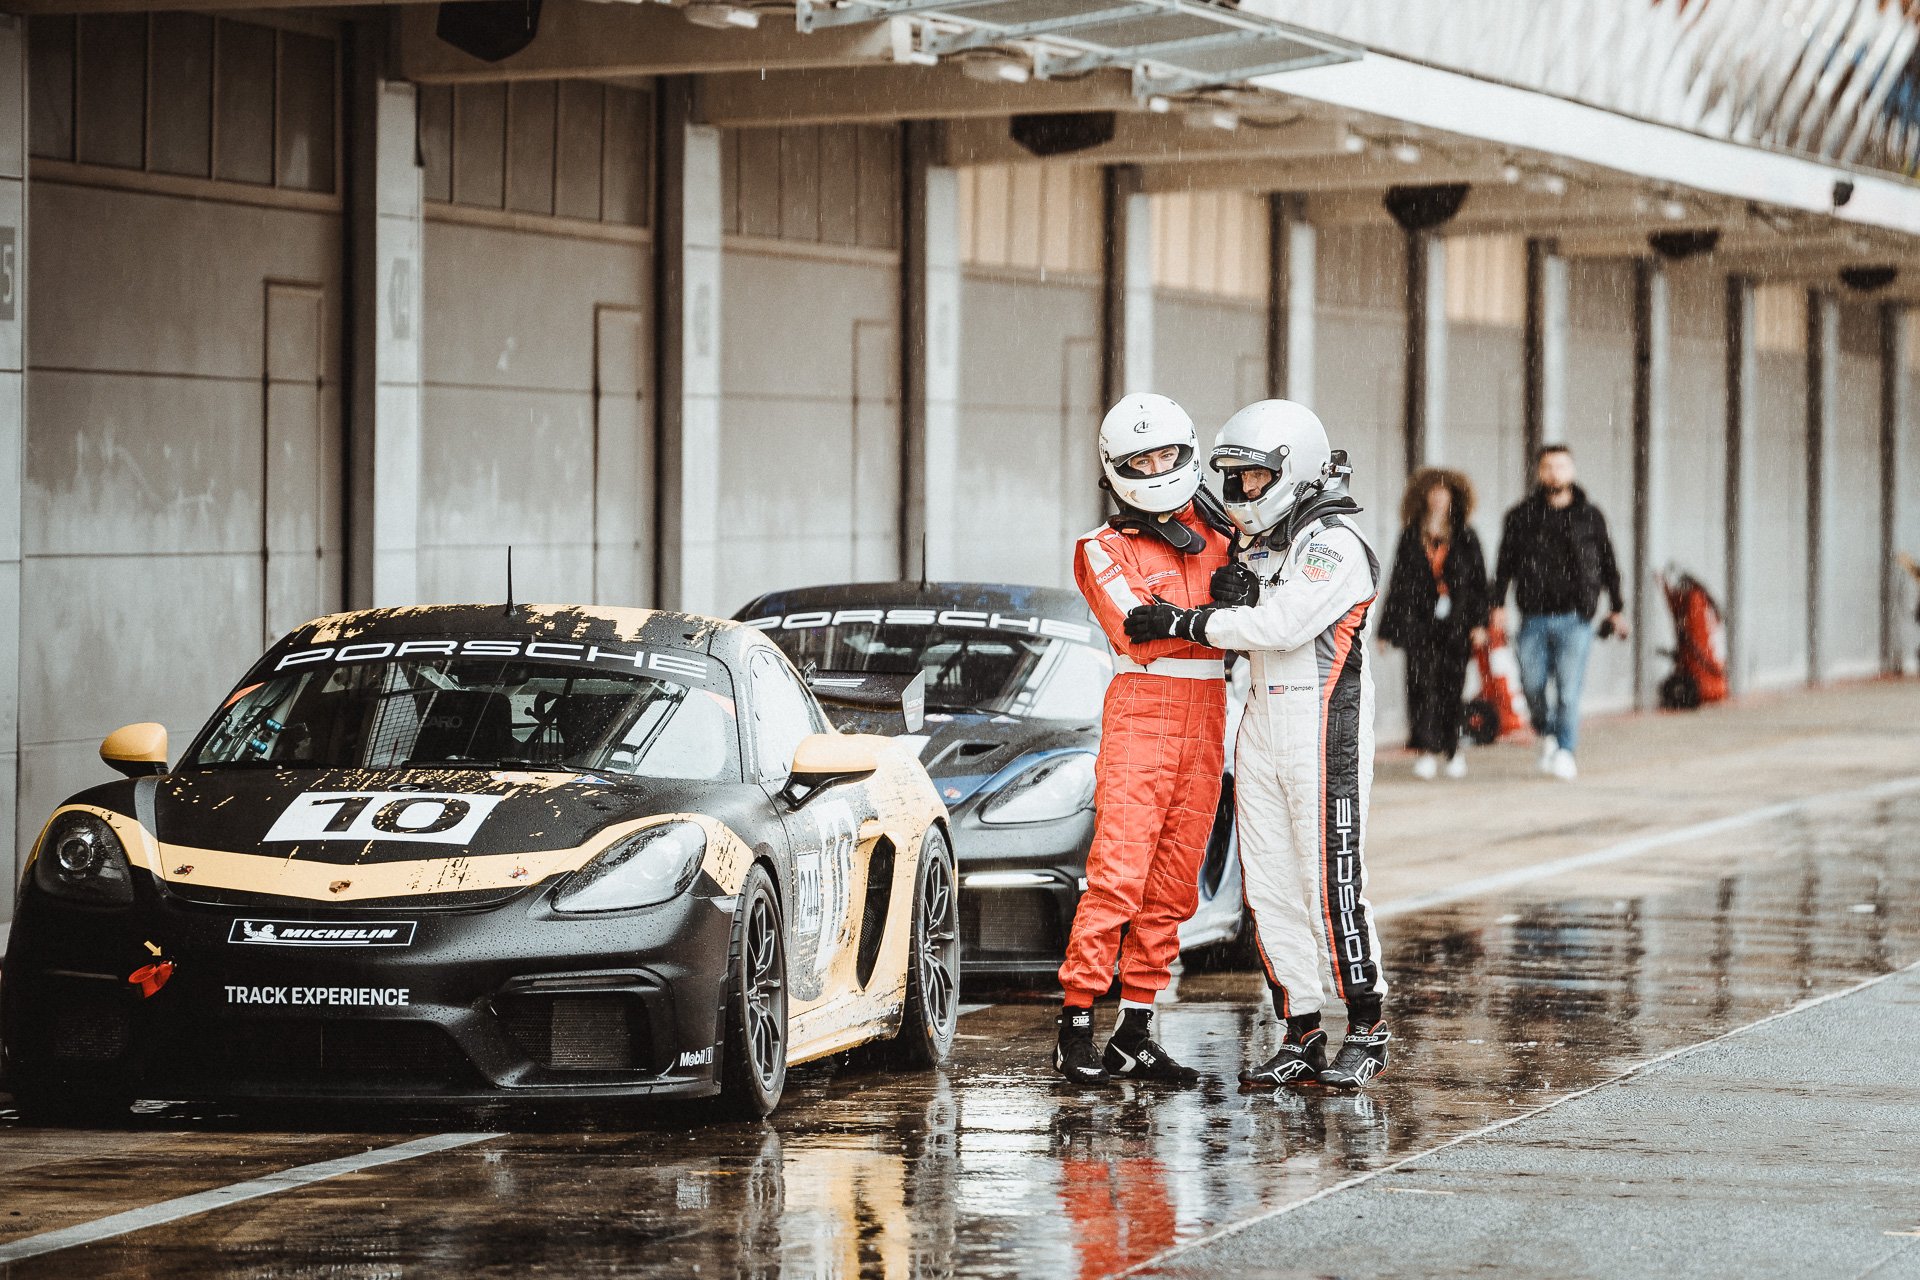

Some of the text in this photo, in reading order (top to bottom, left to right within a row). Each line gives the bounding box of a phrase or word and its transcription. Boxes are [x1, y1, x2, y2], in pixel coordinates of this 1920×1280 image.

[1308, 557, 1334, 571] TAG
[274, 640, 708, 680] PORSCHE
[310, 796, 471, 834] 10
[1336, 798, 1368, 985] PORSCHE
[279, 928, 398, 939] MICHELIN
[225, 985, 409, 1006] TRACK EXPERIENCE
[680, 1049, 705, 1067] Mobil
